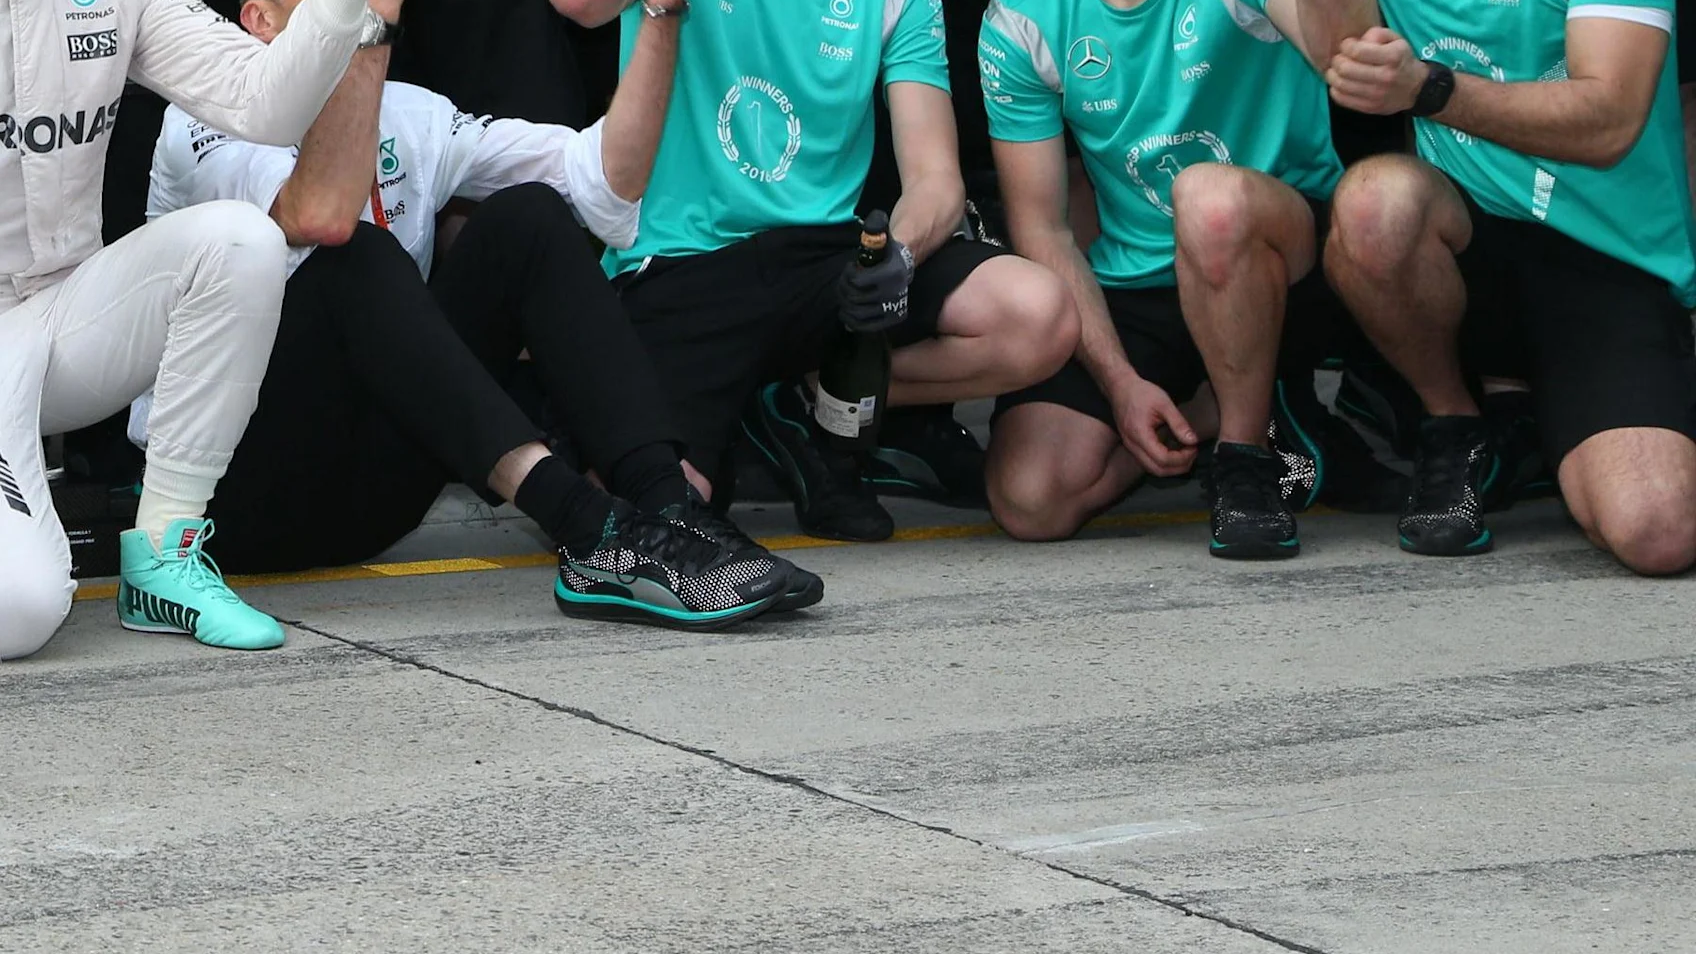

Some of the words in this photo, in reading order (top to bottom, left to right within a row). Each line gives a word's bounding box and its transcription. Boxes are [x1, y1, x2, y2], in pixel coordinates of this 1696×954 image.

[66, 7, 115, 20] PETRONAS
[70, 33, 118, 54] BOSS
[819, 42, 853, 58] BOSS
[1435, 36, 1491, 66] WINNERS
[739, 75, 794, 115] WINNERS
[1094, 99, 1118, 112] UBS
[1139, 130, 1197, 154] WINNERS
